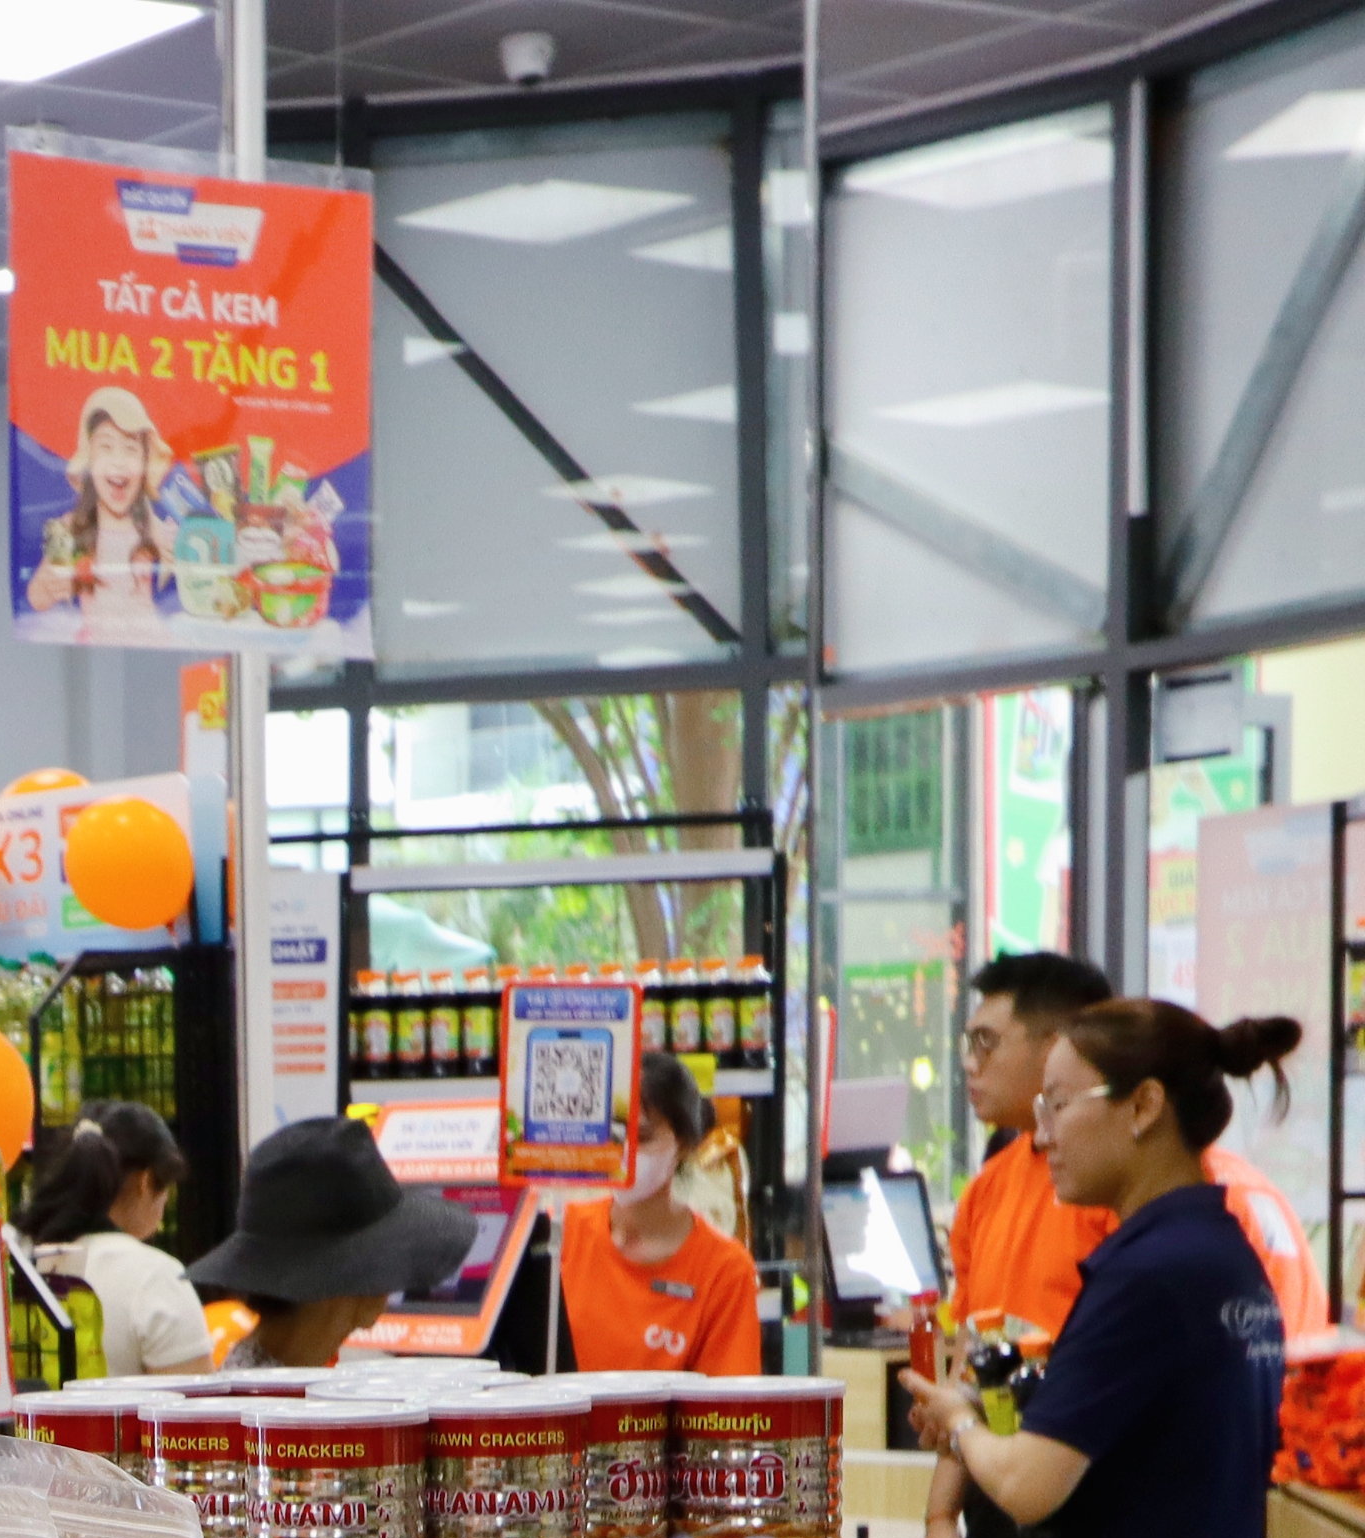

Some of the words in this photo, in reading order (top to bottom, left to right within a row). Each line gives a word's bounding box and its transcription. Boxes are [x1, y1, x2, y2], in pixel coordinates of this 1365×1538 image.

[98, 270, 154, 312] TẤT
[160, 279, 205, 323] CẢ
[210, 291, 278, 327] KEM
[45, 326, 140, 377] MUA
[149, 337, 175, 379] 2
[184, 330, 297, 395] TẶNG
[309, 350, 333, 392] 1
[156, 1436, 230, 1452] CRACKERS
[479, 1430, 565, 1448] CRACKERS
[277, 1441, 366, 1459] CRACKERS
